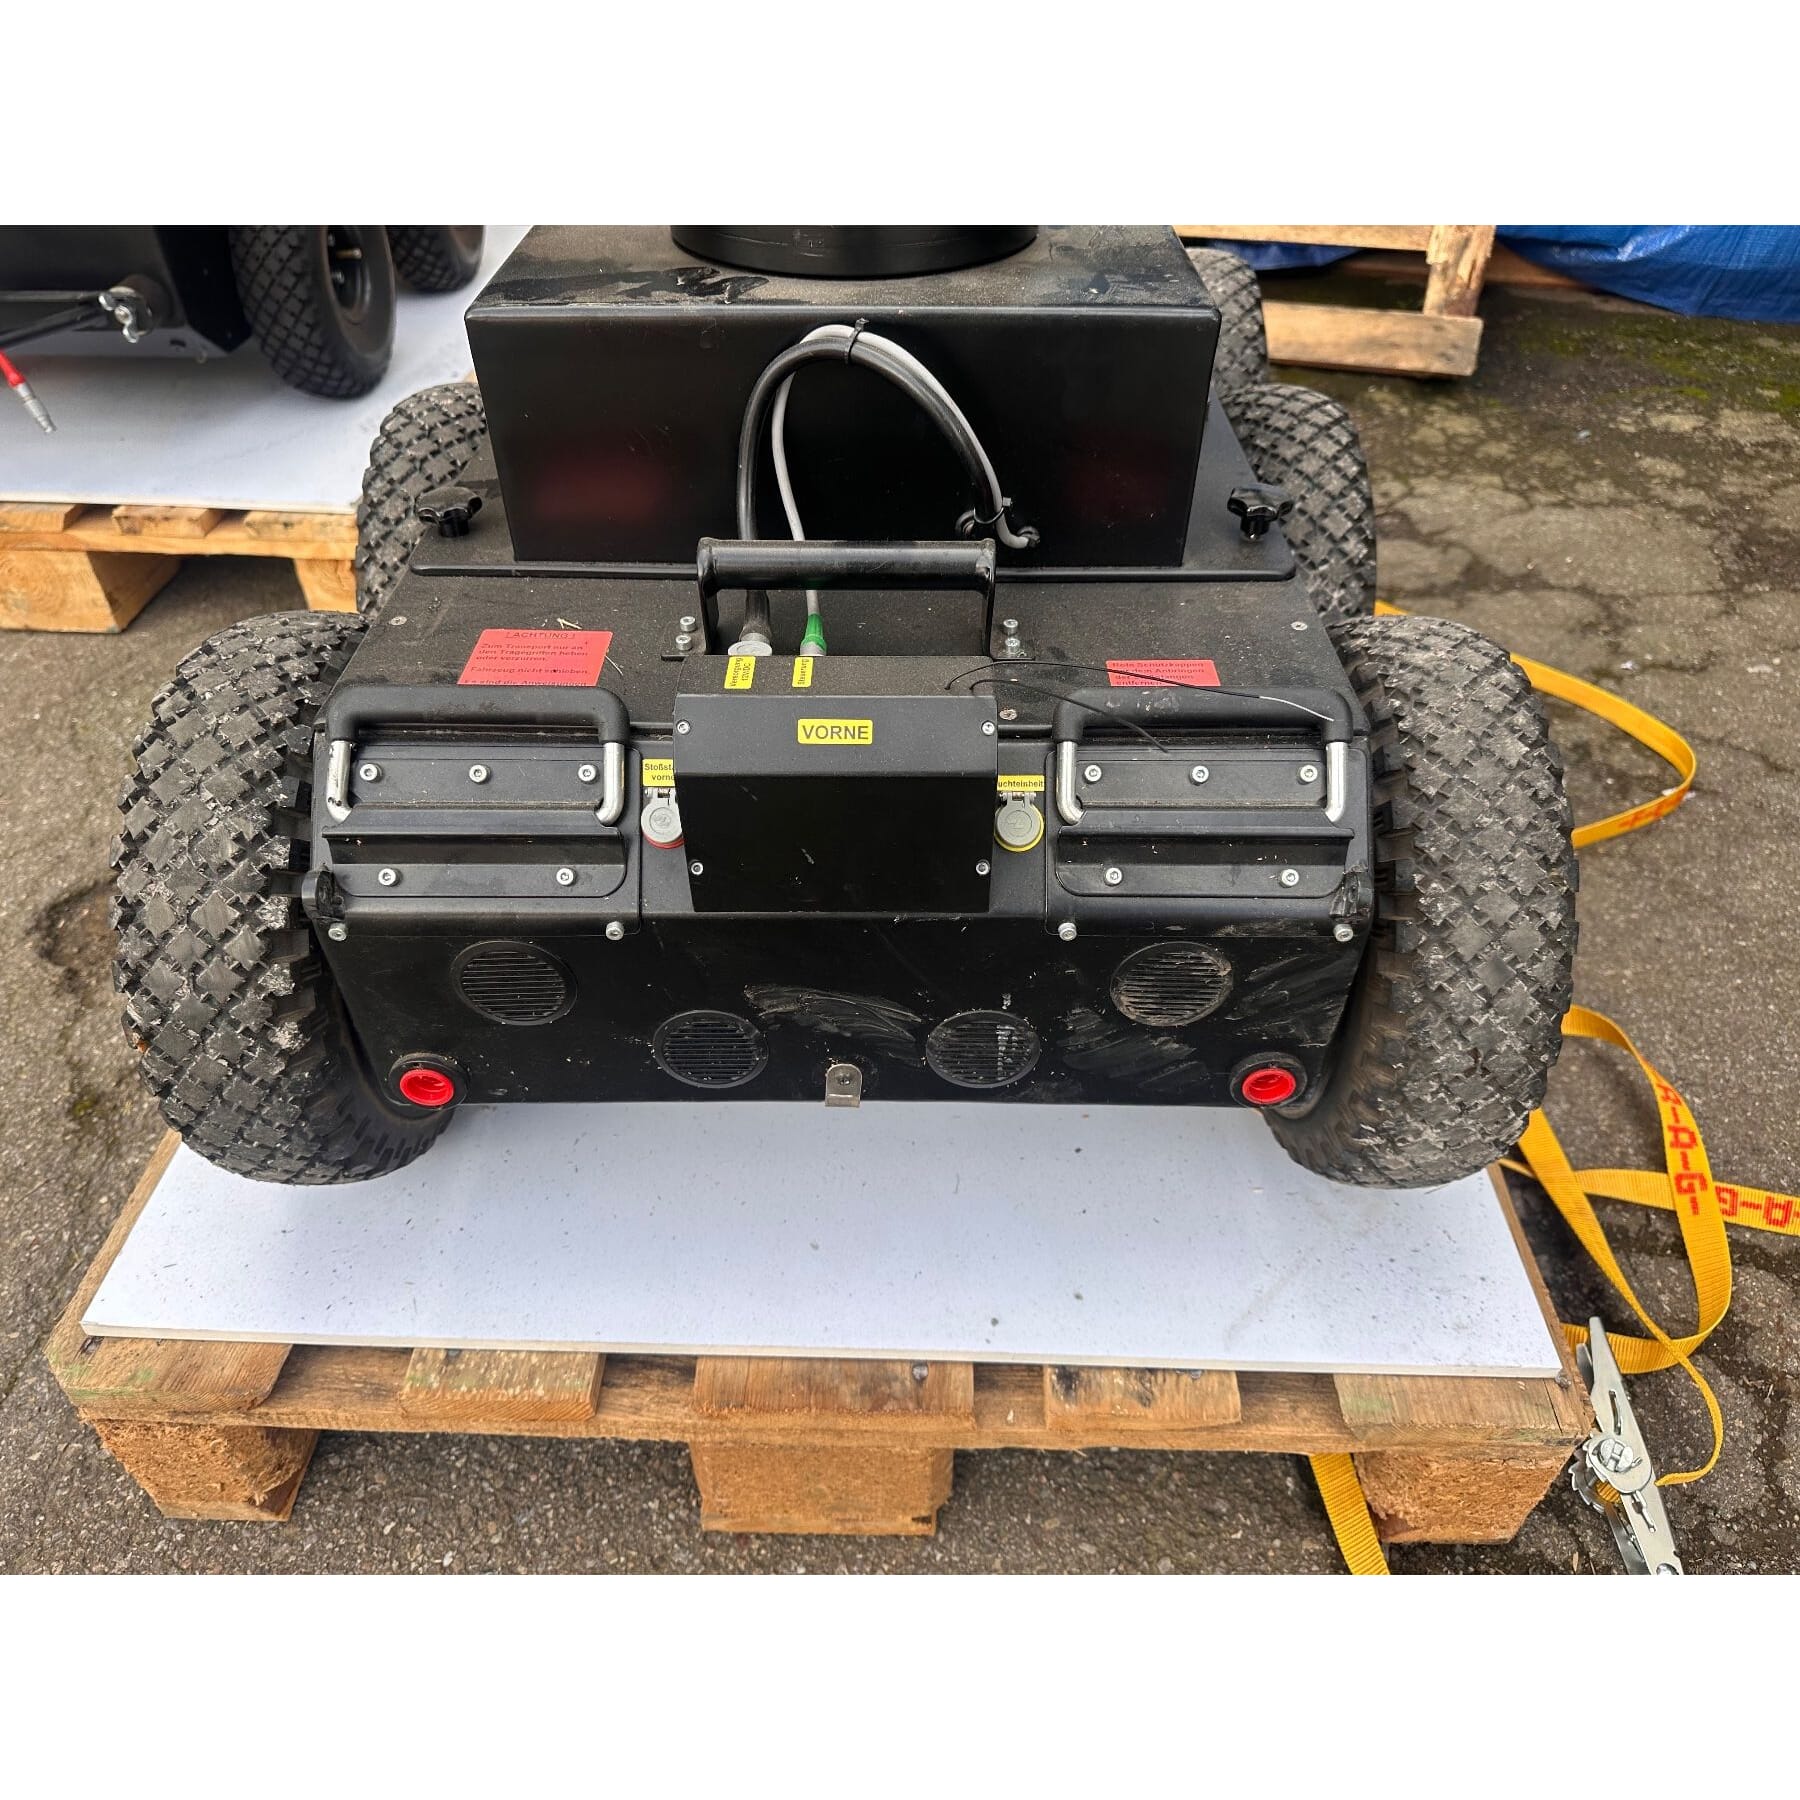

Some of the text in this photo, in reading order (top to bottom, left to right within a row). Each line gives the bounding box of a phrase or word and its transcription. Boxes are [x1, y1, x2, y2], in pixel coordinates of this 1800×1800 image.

[506, 643, 552, 651] Transport
[802, 725, 869, 740] VORNE
[644, 763, 674, 771] Stoßst
